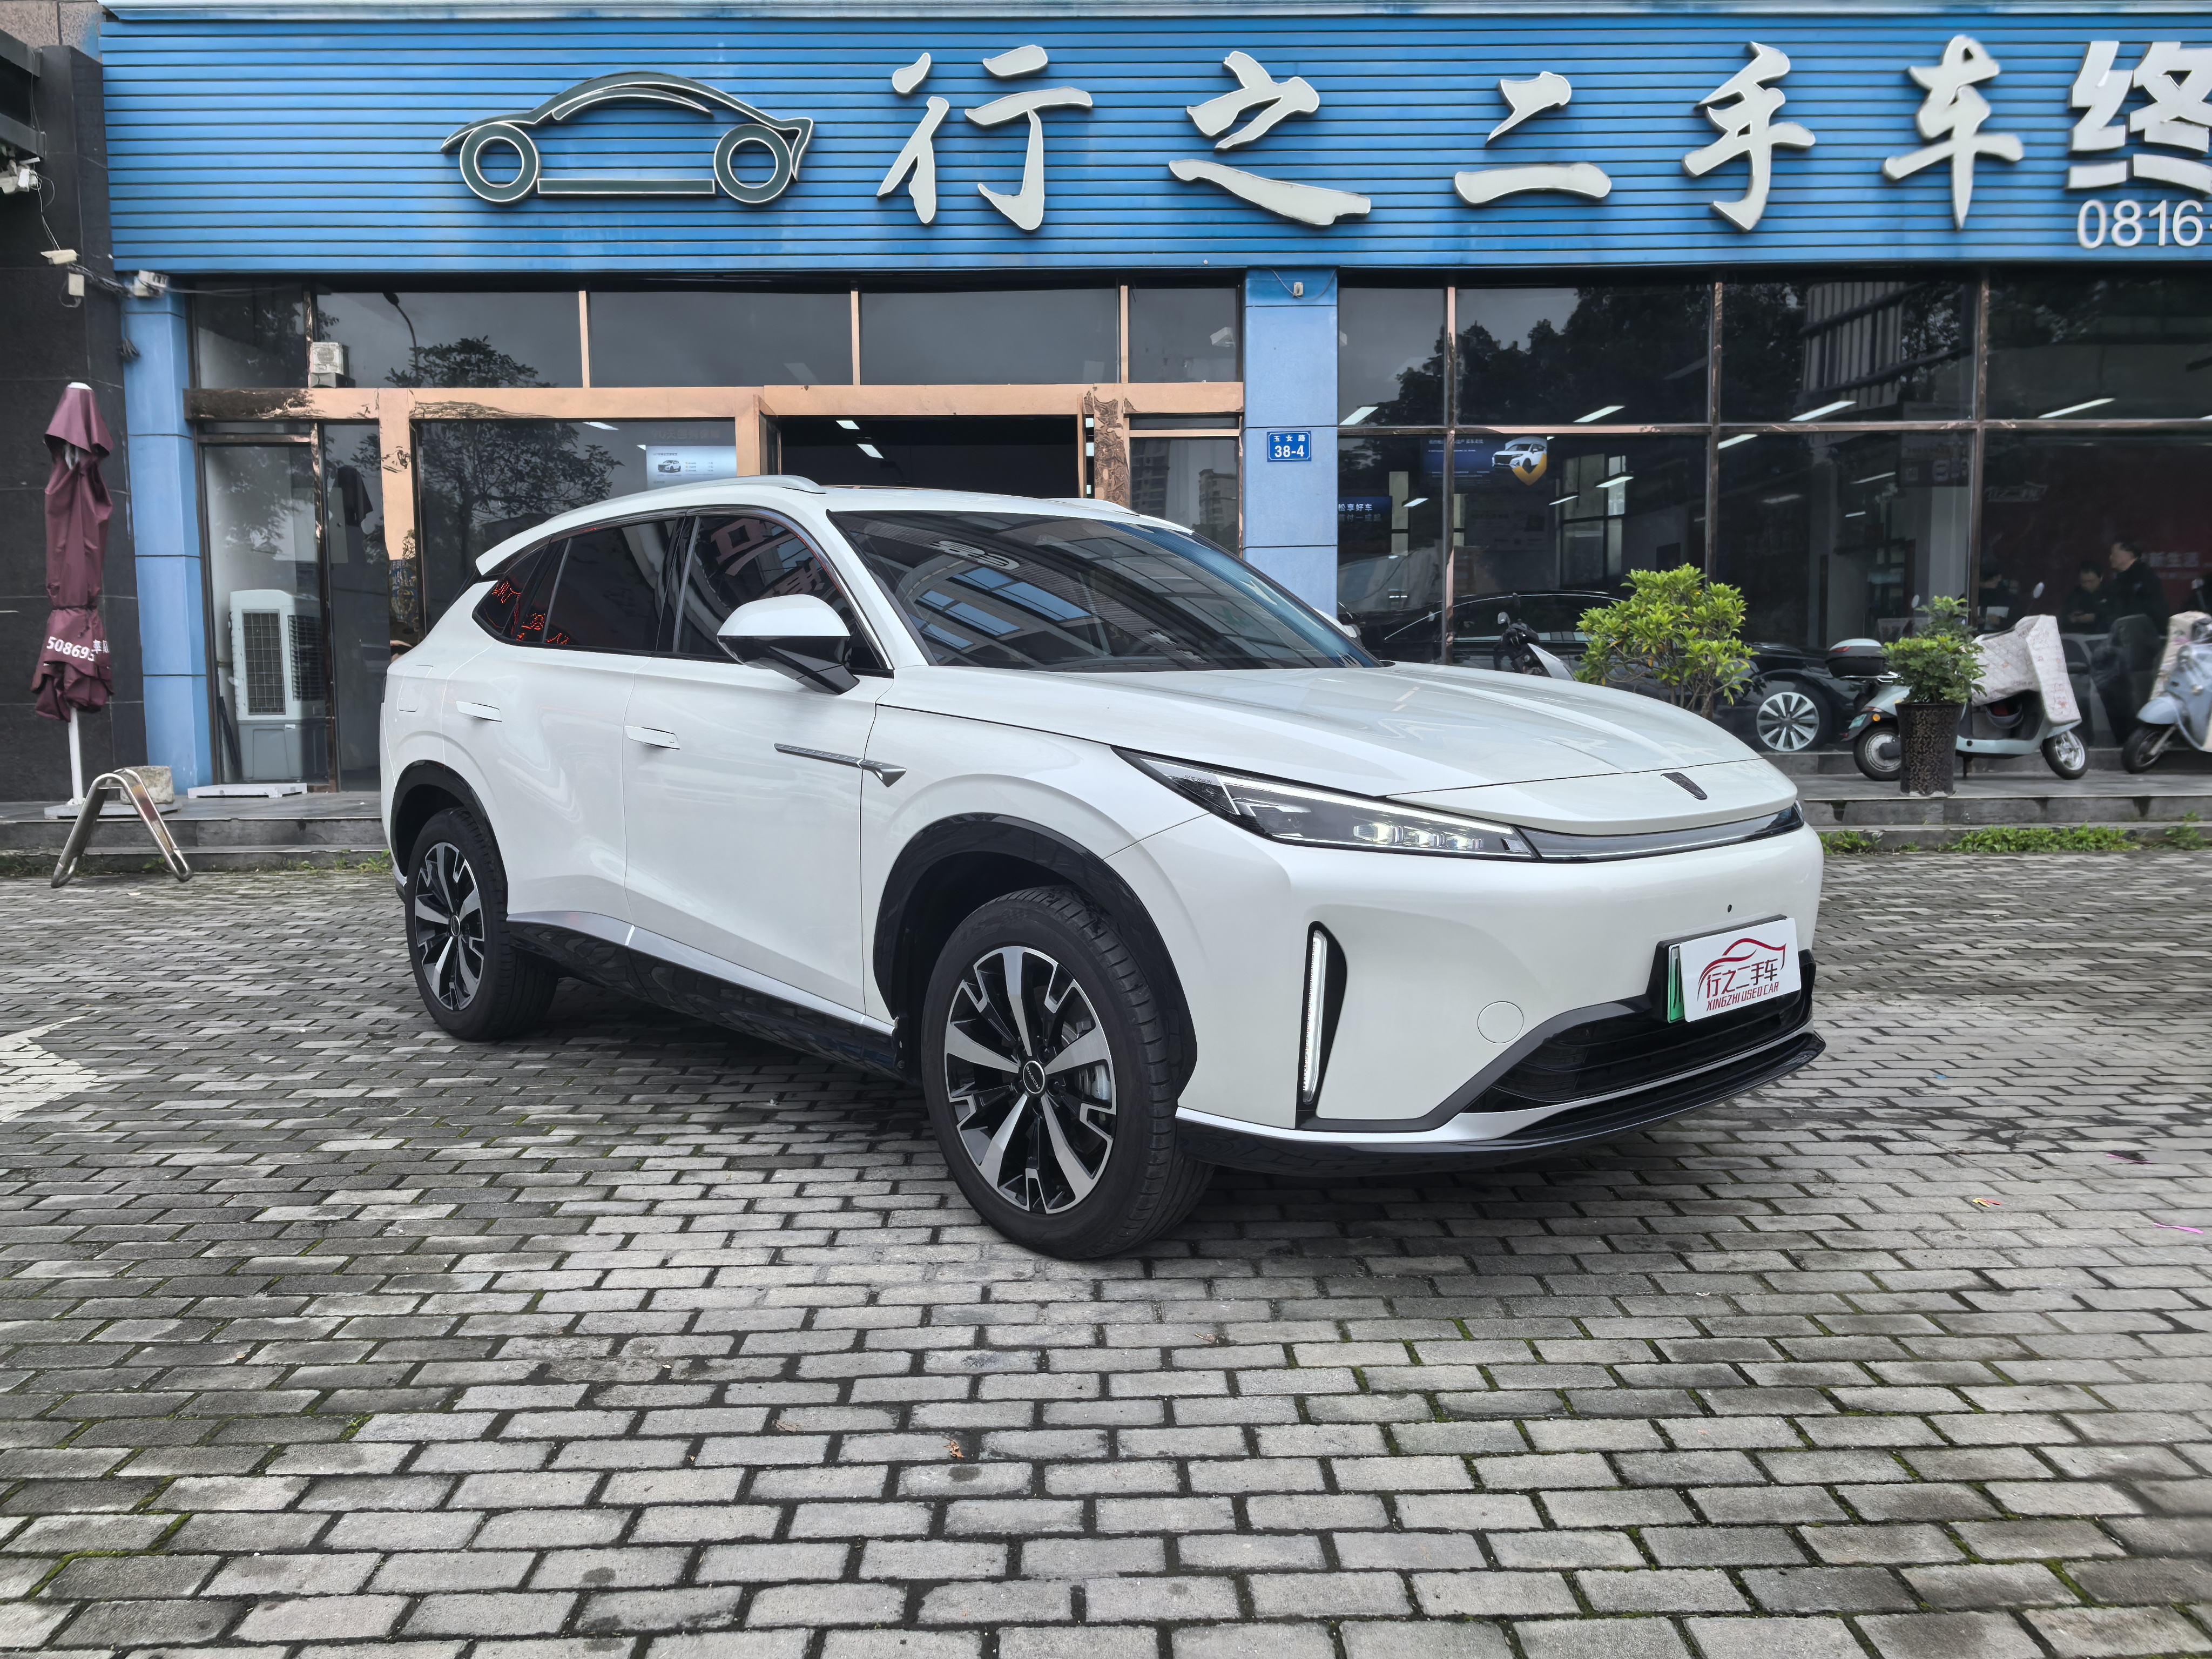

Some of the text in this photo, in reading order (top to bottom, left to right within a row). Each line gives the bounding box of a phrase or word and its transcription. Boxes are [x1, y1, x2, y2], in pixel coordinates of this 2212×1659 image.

[1274, 444, 1305, 457] 38-4
[1707, 958, 1778, 999] 行之二手车
[1705, 981, 1779, 1011] XINGZHI USED CAR
